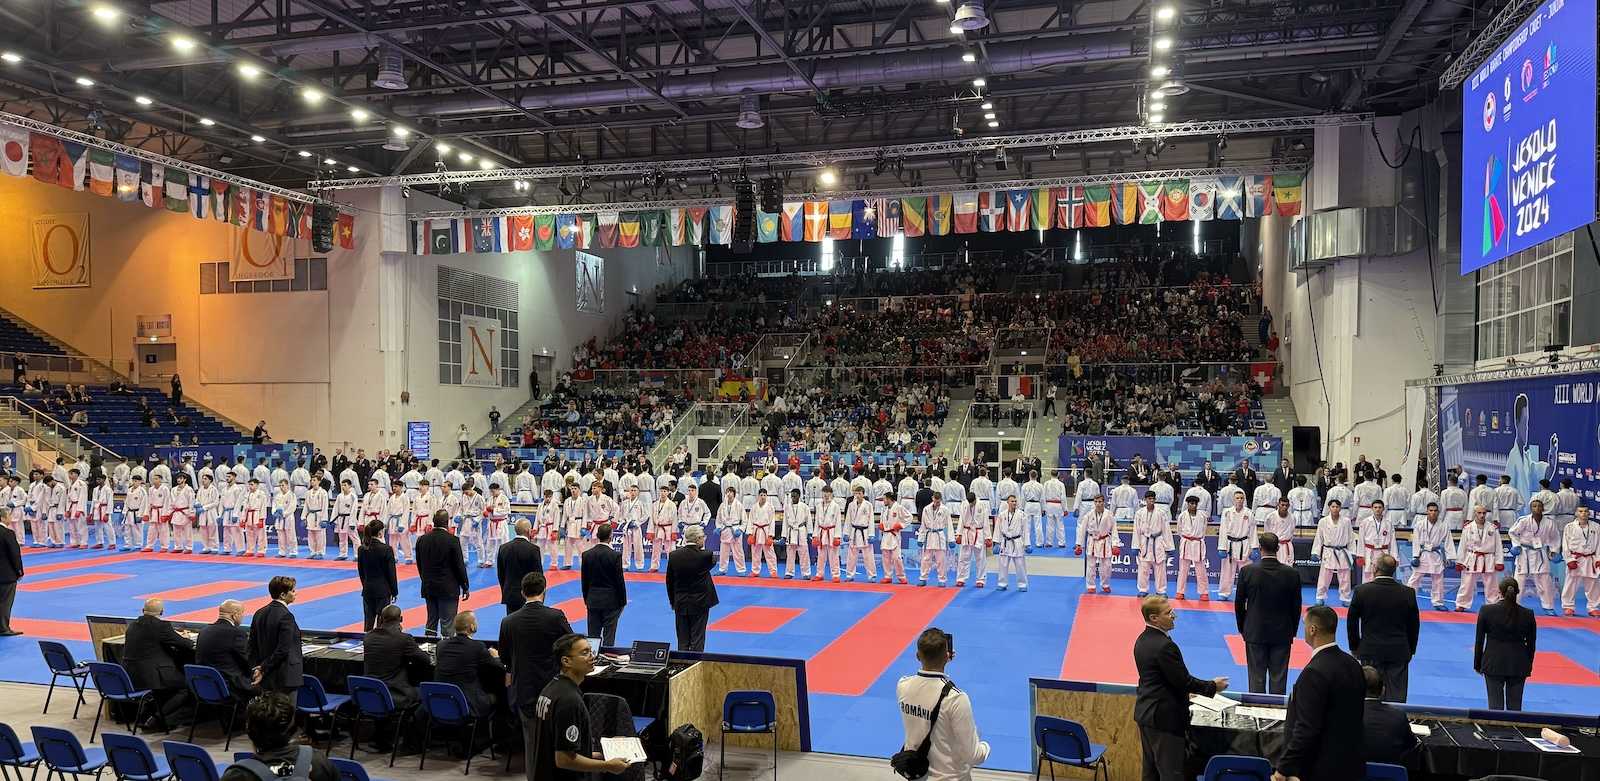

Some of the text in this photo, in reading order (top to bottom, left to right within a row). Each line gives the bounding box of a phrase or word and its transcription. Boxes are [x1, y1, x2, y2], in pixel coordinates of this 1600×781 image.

[1512, 118, 1557, 173] JESOLO
[1512, 153, 1557, 207] VENICE
[1516, 193, 1550, 236] 2024
[43, 224, 79, 275] O
[581, 261, 600, 305] N
[468, 326, 496, 376] N
[1554, 384, 1570, 404] XIII
[1572, 382, 1594, 404] WORLD
